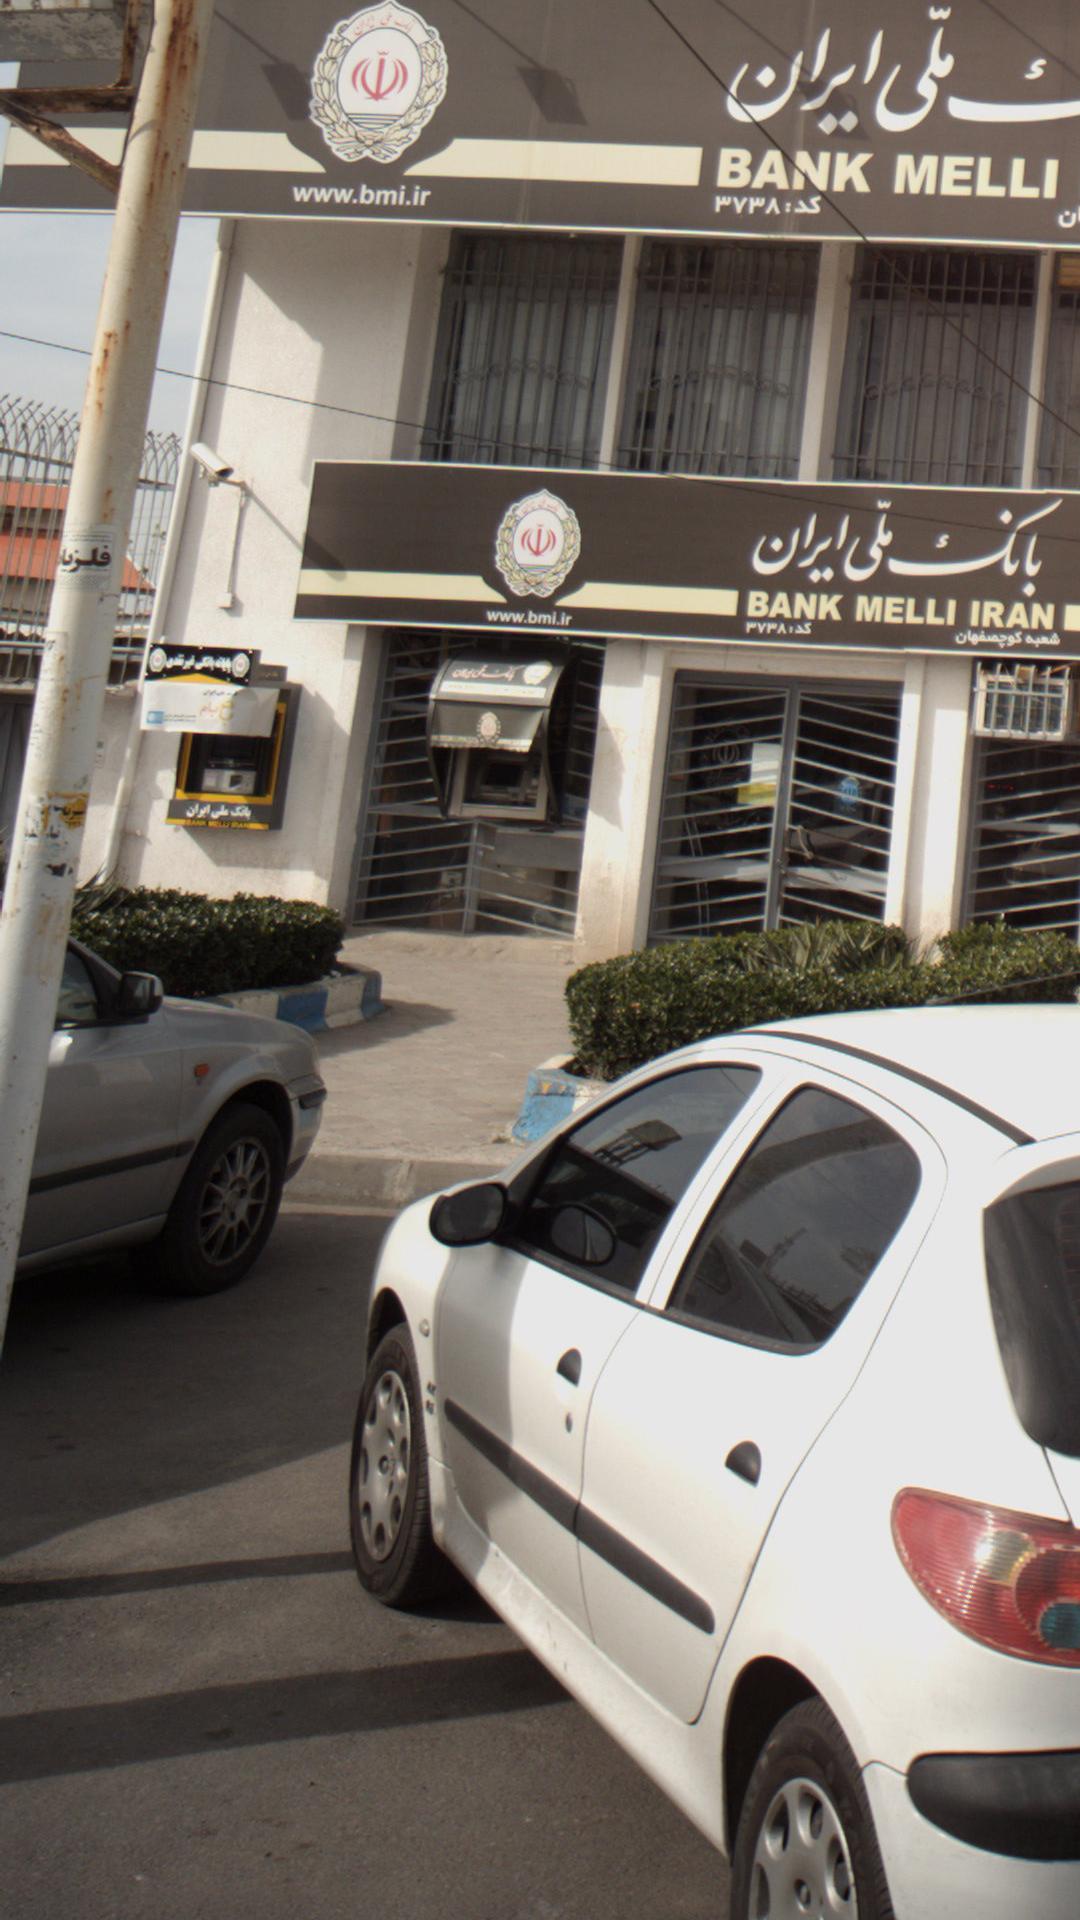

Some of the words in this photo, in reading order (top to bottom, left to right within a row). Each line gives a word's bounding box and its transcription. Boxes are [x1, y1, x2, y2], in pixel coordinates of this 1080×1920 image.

[726, 28, 884, 135] ایران
[716, 147, 874, 193] BANK
[893, 154, 1060, 199] MELLI
[292, 184, 431, 206] www.bmi.ir
[752, 513, 850, 583] ایران
[486, 610, 573, 627] www.bmi.ir
[746, 590, 844, 621] BANK
[855, 596, 957, 626] MELLI
[969, 600, 1055, 631] IRAN
[955, 629, 1023, 649] کوچصفهان
[1024, 632, 1061, 648] شعبه
[186, 803, 211, 819] ایران
[211, 804, 229, 819] ملی
[230, 804, 252, 821] بانک
